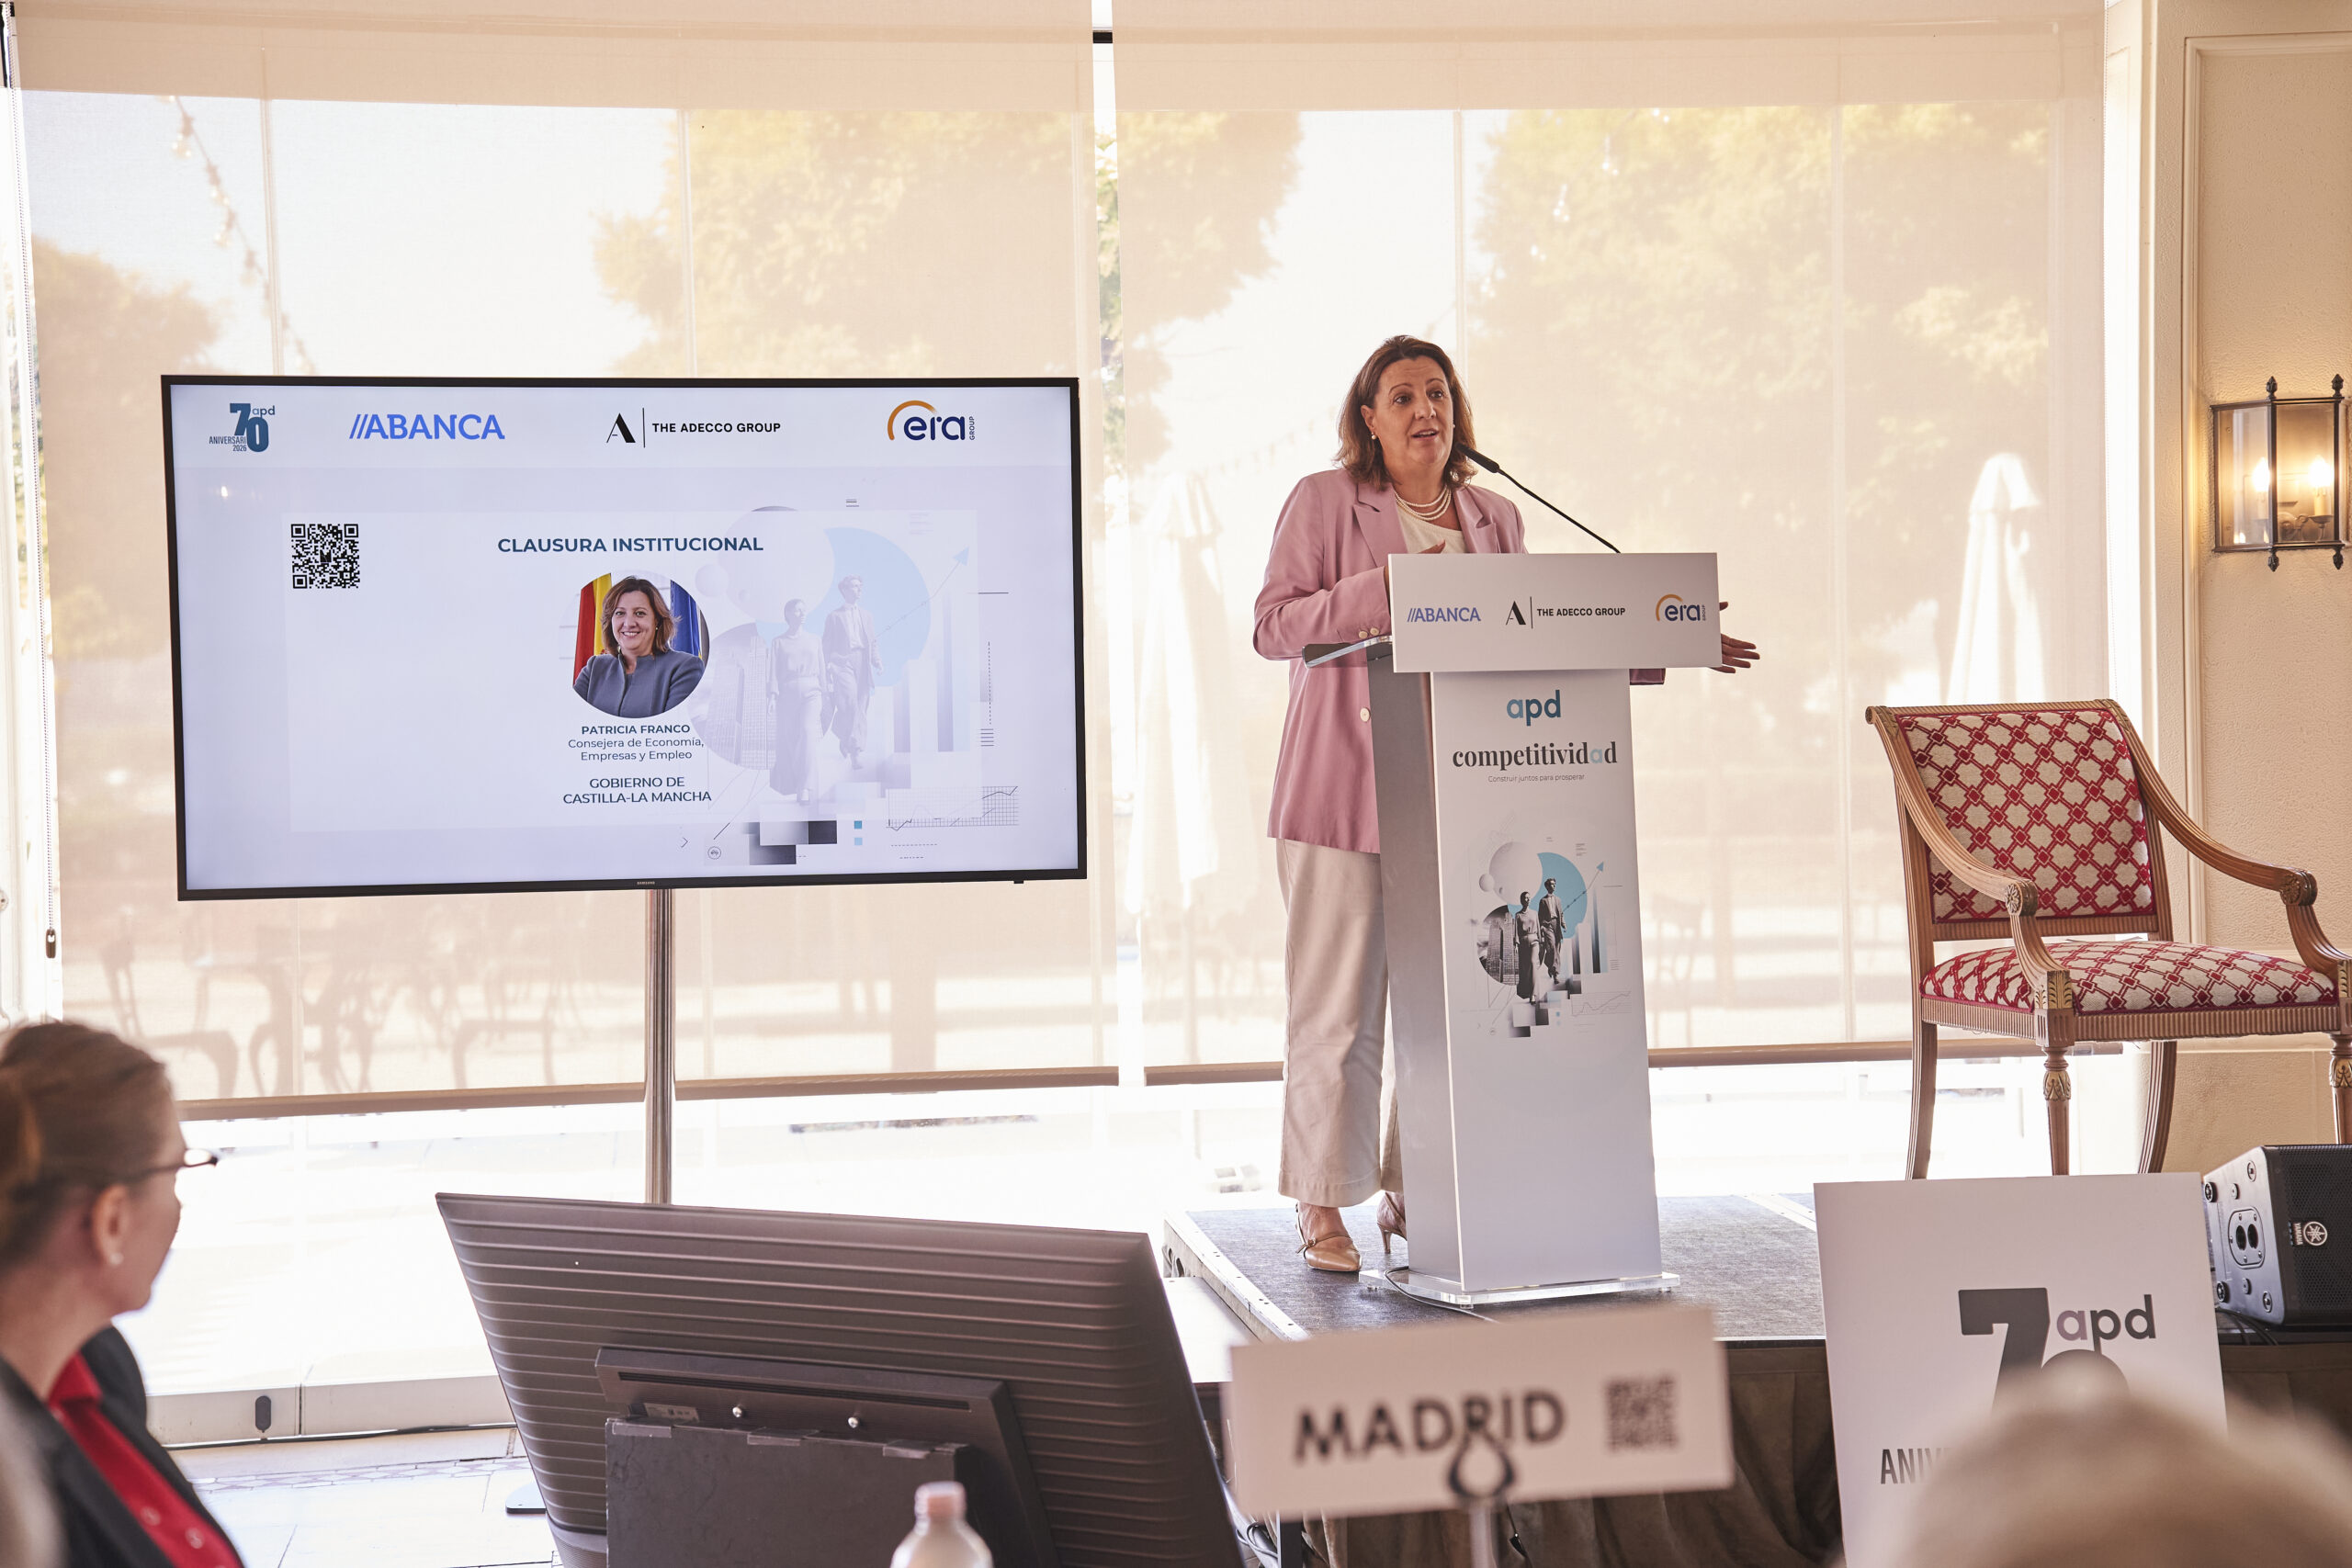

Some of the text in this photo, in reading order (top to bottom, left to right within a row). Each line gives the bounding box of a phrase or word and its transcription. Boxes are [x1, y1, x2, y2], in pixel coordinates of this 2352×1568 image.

[252, 405, 275, 418] apd
[230, 402, 269, 453] 70
[652, 423, 676, 433] THE
[680, 423, 733, 433] ADECCO
[736, 423, 781, 433] GROUP
[903, 416, 966, 441] era
[497, 537, 763, 553] CLAUSURA INSTITUCIONAL
[1536, 608, 1554, 616] THE
[1555, 608, 1593, 616] ADECCO
[1595, 607, 1626, 616] GROUP
[1664, 604, 1701, 622] era
[1506, 690, 1561, 727] apd
[582, 724, 691, 735] PATRICIA FRANCO
[568, 737, 705, 750] Consejera de Economía,
[581, 750, 693, 762] Empresas y Empleo
[1453, 741, 1618, 771] competitividad
[589, 776, 685, 788] GOBIERNO DE
[1518, 774, 1538, 783] juntos
[1555, 774, 1585, 783] prosperar
[563, 791, 712, 804] CASTILLA-LA MANCHA
[2055, 1293, 2157, 1354] apd
[1293, 1388, 1567, 1464] MADRID
